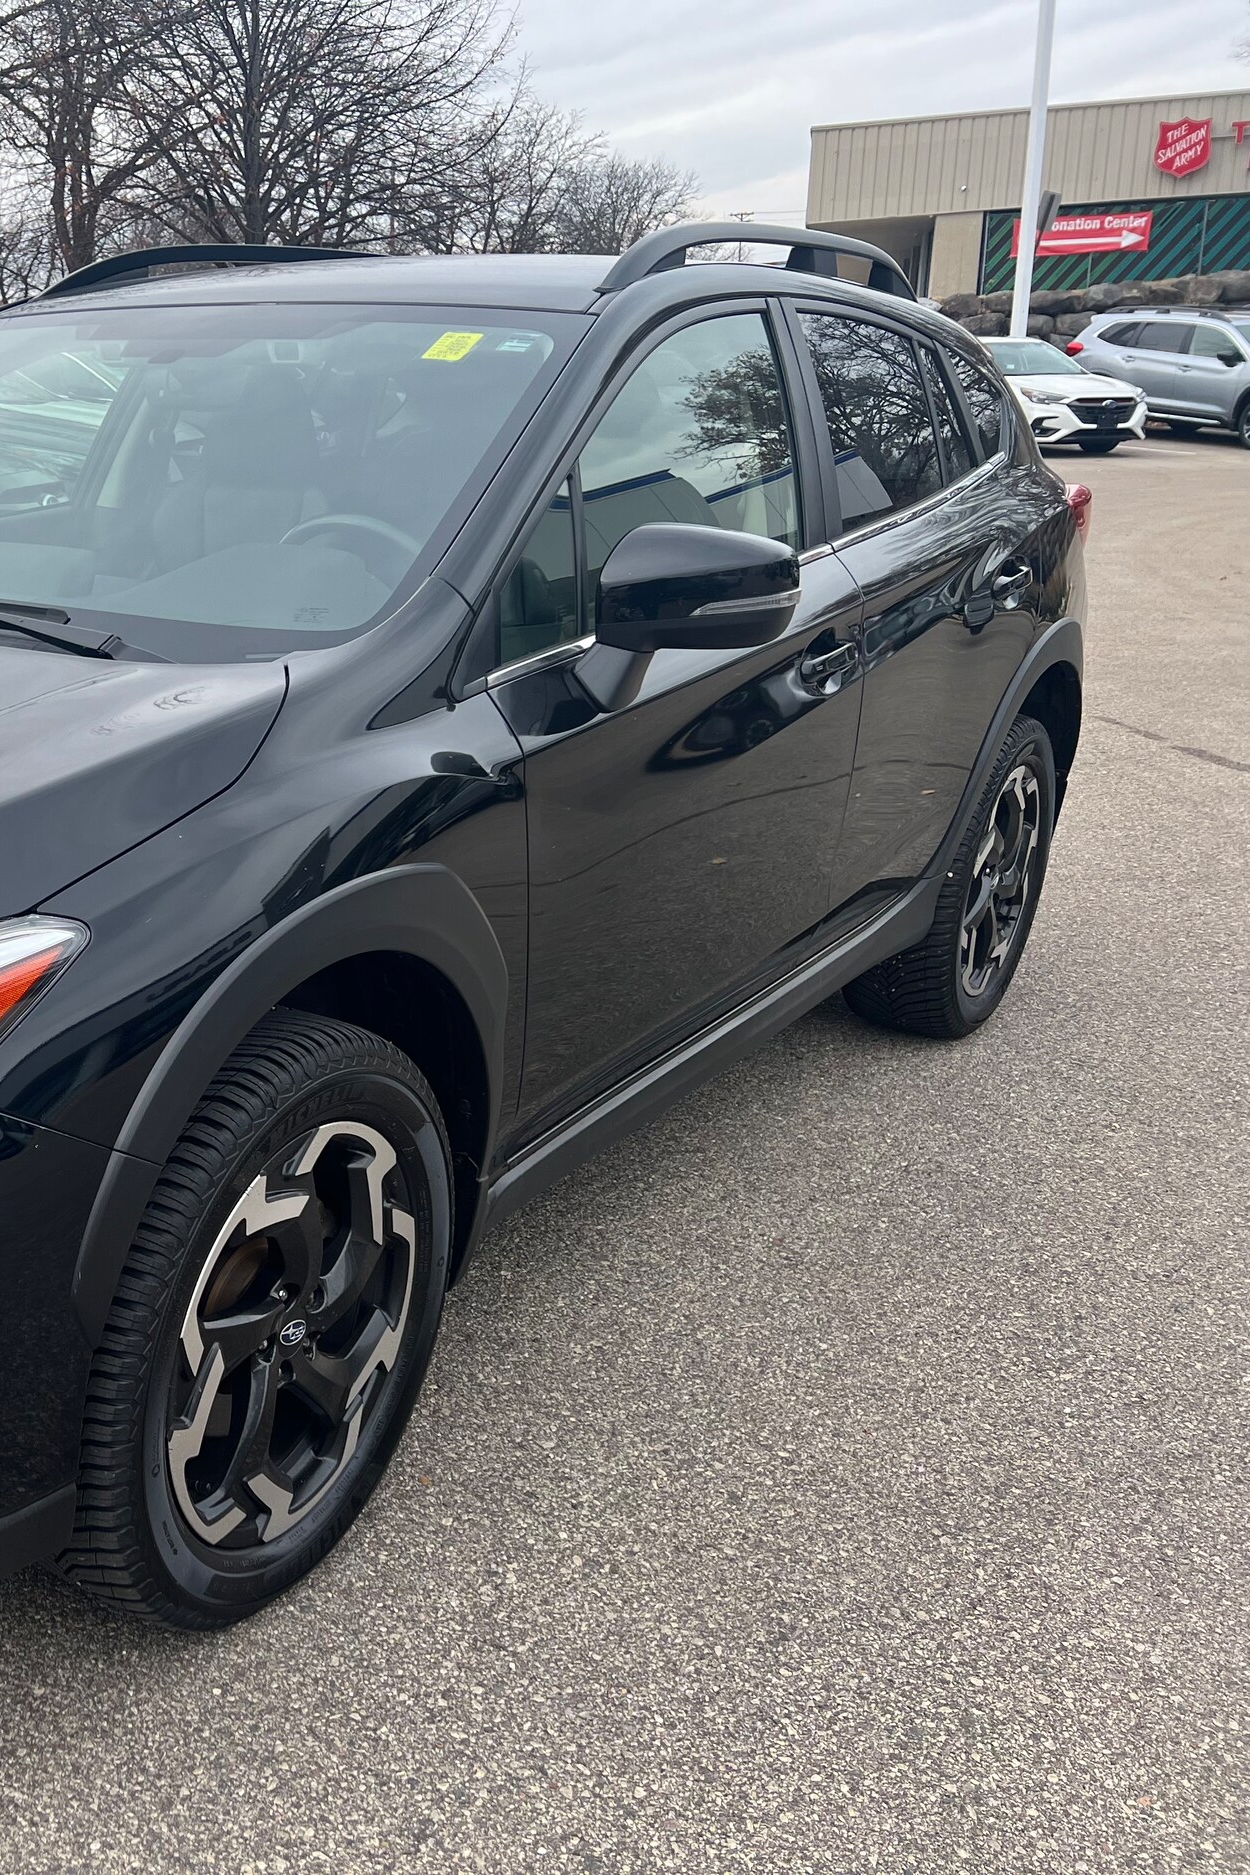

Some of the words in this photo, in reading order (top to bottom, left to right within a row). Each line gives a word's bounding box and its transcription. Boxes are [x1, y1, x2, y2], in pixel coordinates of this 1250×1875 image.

[1157, 124, 1207, 163] SALVATION
[1166, 123, 1190, 144] THE
[1172, 141, 1204, 171] ARMY
[1051, 217, 1101, 231] onation
[1103, 215, 1148, 229] Center
